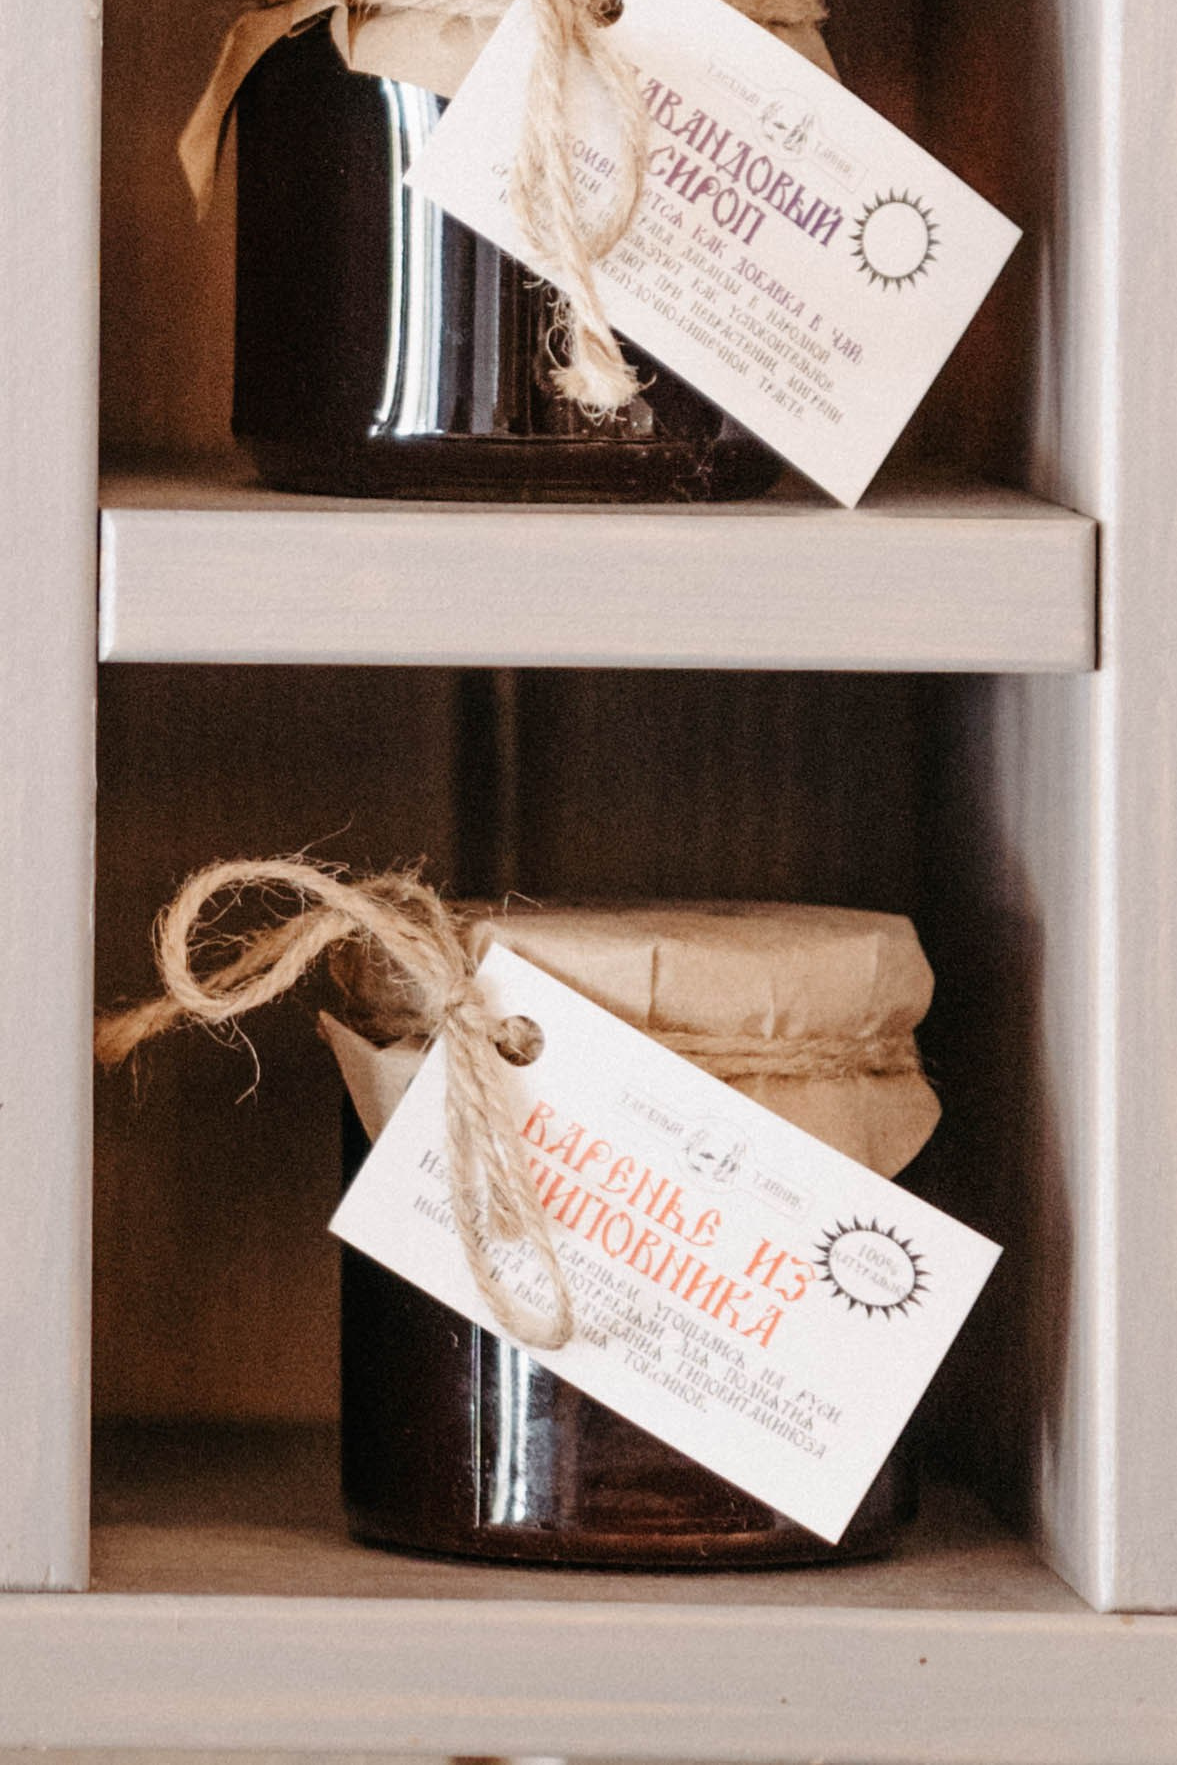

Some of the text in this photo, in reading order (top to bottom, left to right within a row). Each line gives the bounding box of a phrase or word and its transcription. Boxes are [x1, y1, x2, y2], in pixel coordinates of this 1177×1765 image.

[613, 60, 849, 251] АВАНДОВЫЙ
[640, 135, 769, 247] СИРОП
[690, 224, 728, 259] КАК
[730, 254, 807, 318] ДОБАВКА
[807, 312, 825, 333] В
[690, 276, 721, 304] КАК
[518, 1098, 731, 1252] ВАРЕНЬЕ
[741, 1235, 820, 1308] ИЗ
[648, 1300, 750, 1374] УГОЩАЛИСЬ
[758, 1366, 786, 1391] НА
[674, 1337, 713, 1371] ДЛЯ
[721, 1365, 818, 1434] ПОДНЯТИЯ
